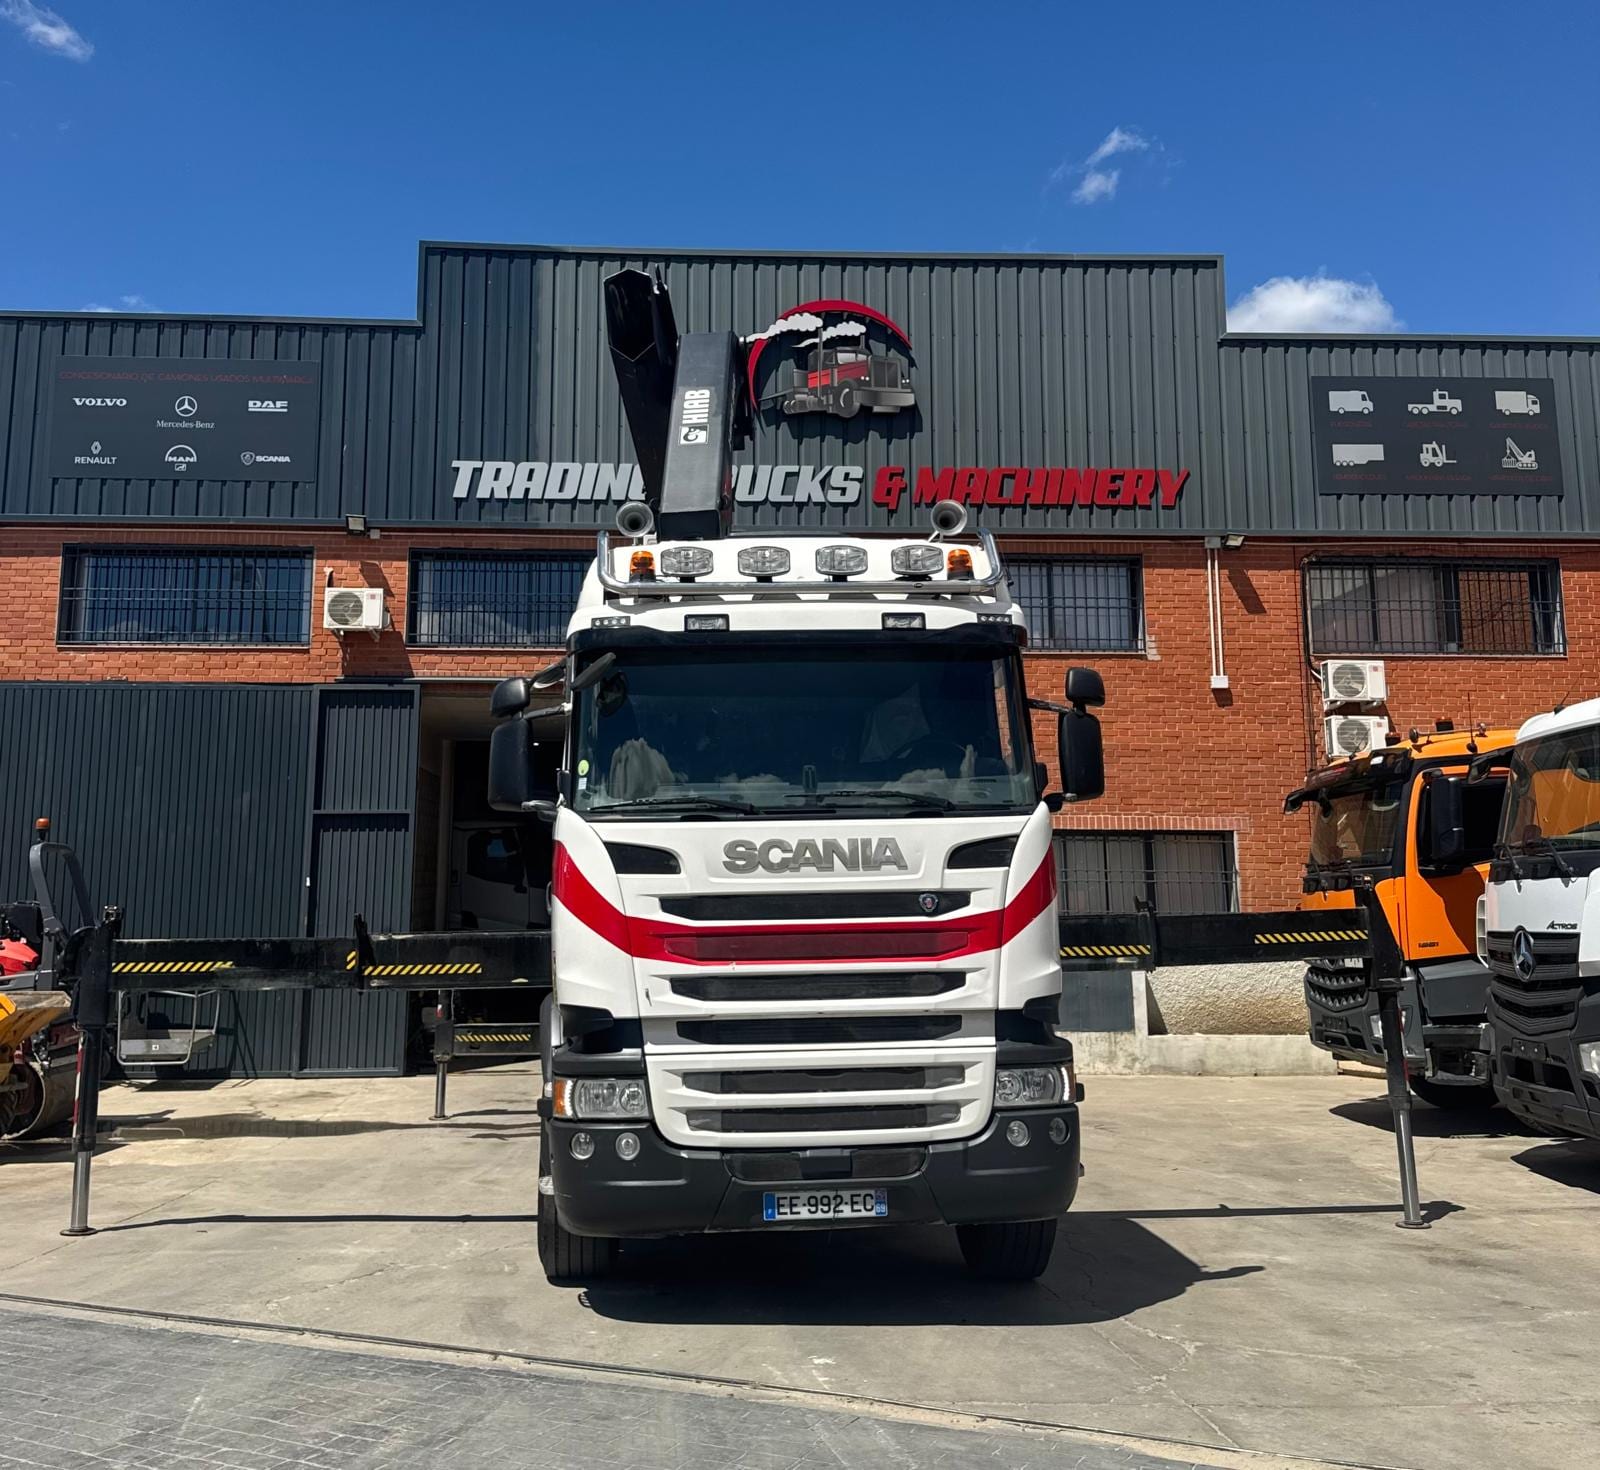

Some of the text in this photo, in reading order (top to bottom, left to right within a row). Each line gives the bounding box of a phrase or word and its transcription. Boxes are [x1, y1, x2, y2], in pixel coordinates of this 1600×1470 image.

[72, 398, 127, 407] VOLVO
[248, 400, 288, 409] DAF
[682, 389, 710, 424] HIAB
[156, 420, 215, 429] Mercedes-Benz
[74, 456, 117, 465] RENAULT
[255, 455, 291, 463] SCANIA
[872, 466, 906, 510] &
[913, 466, 1190, 506] MACHINERY
[722, 837, 909, 875] SCANIA
[777, 1193, 874, 1215] EE-992-EC
